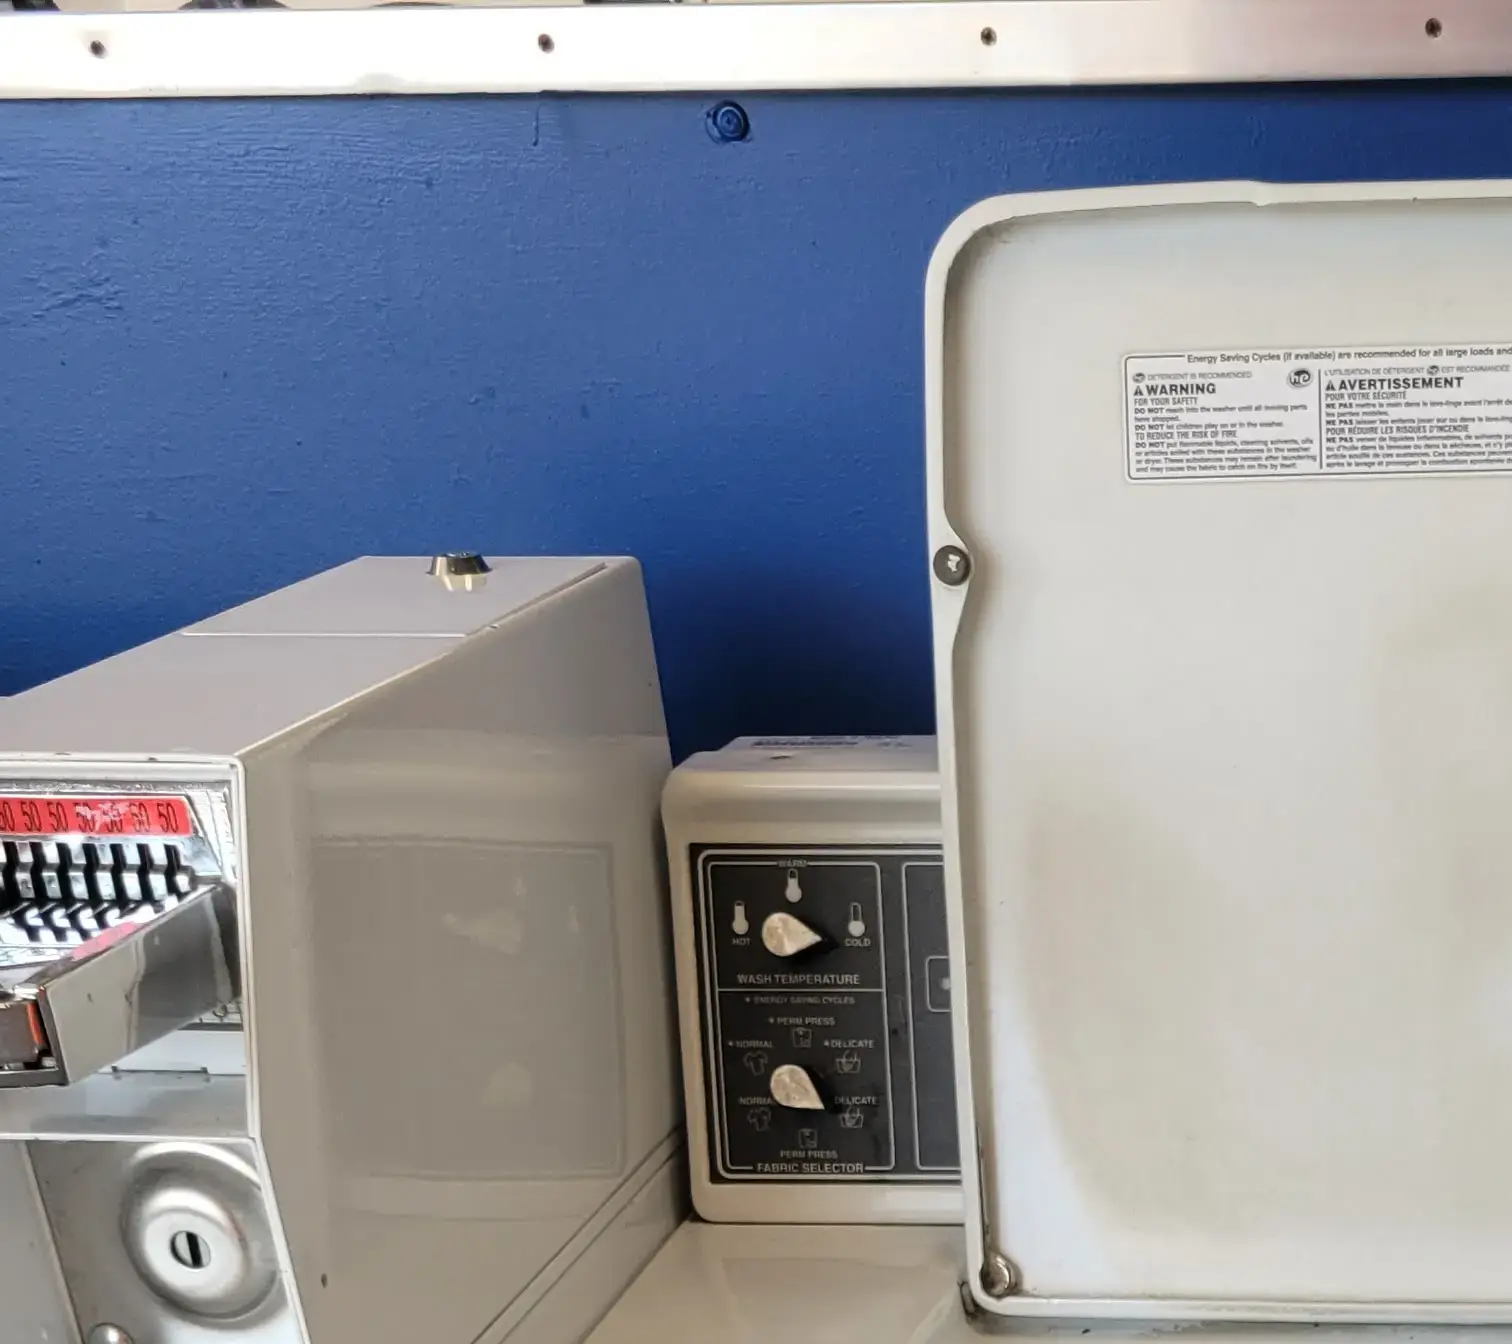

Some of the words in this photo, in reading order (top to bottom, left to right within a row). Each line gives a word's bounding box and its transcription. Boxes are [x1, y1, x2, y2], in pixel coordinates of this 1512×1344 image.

[1188, 353, 1218, 364] Energy
[1219, 352, 1250, 364] Saving
[1251, 352, 1281, 363] Cycles
[1282, 351, 1292, 362] (if
[1294, 350, 1336, 362] available)
[1337, 351, 1352, 359] are
[1353, 348, 1416, 359] recommended
[1418, 348, 1431, 356] for
[1432, 348, 1443, 356] all
[1445, 347, 1468, 358] large
[1469, 346, 1494, 356] loads
[1496, 346, 1512, 355] and
[1338, 376, 1464, 391] AVERTISSEMENT
[1146, 382, 1216, 396] WARNING
[1324, 392, 1346, 401] POUR
[1345, 391, 1371, 400] VOTRE
[1371, 389, 1408, 400] SÉCURITÉ
[1133, 397, 1148, 406] FOR
[1148, 396, 1170, 406] YOUR
[1171, 396, 1198, 405] SAFETY
[1134, 431, 1145, 440] TO
[1146, 431, 1175, 440] REDUCE
[1175, 430, 1190, 439] THE
[1190, 429, 1209, 439] RISK
[1209, 429, 1220, 438] OF
[1220, 429, 1238, 438] FIRE
[1324, 426, 1346, 436] POUR
[1346, 425, 1380, 435] RÉDUIRE
[1379, 425, 1394, 434] LES
[1394, 424, 1427, 434] RISQUES
[20, 802, 42, 832] 50
[46, 802, 69, 832] 50
[157, 802, 179, 833] 50
[732, 938, 751, 946] HOT
[844, 938, 871, 947] COLD
[737, 974, 772, 985] WASH
[773, 974, 861, 985] TEMPERATURE
[822, 996, 855, 1004] CYCLES
[776, 1017, 804, 1025] PERM
[805, 1017, 836, 1026] PRESS
[736, 1040, 773, 1048] NORMAL
[831, 1039, 874, 1048] DELICATE
[739, 1097, 772, 1105] NORMA
[834, 1096, 877, 1105] DELICATE
[780, 1150, 806, 1158] PERM
[808, 1150, 838, 1159] PRESS
[756, 1163, 799, 1173] FABRIC
[802, 1162, 864, 1173] SELECTOR
